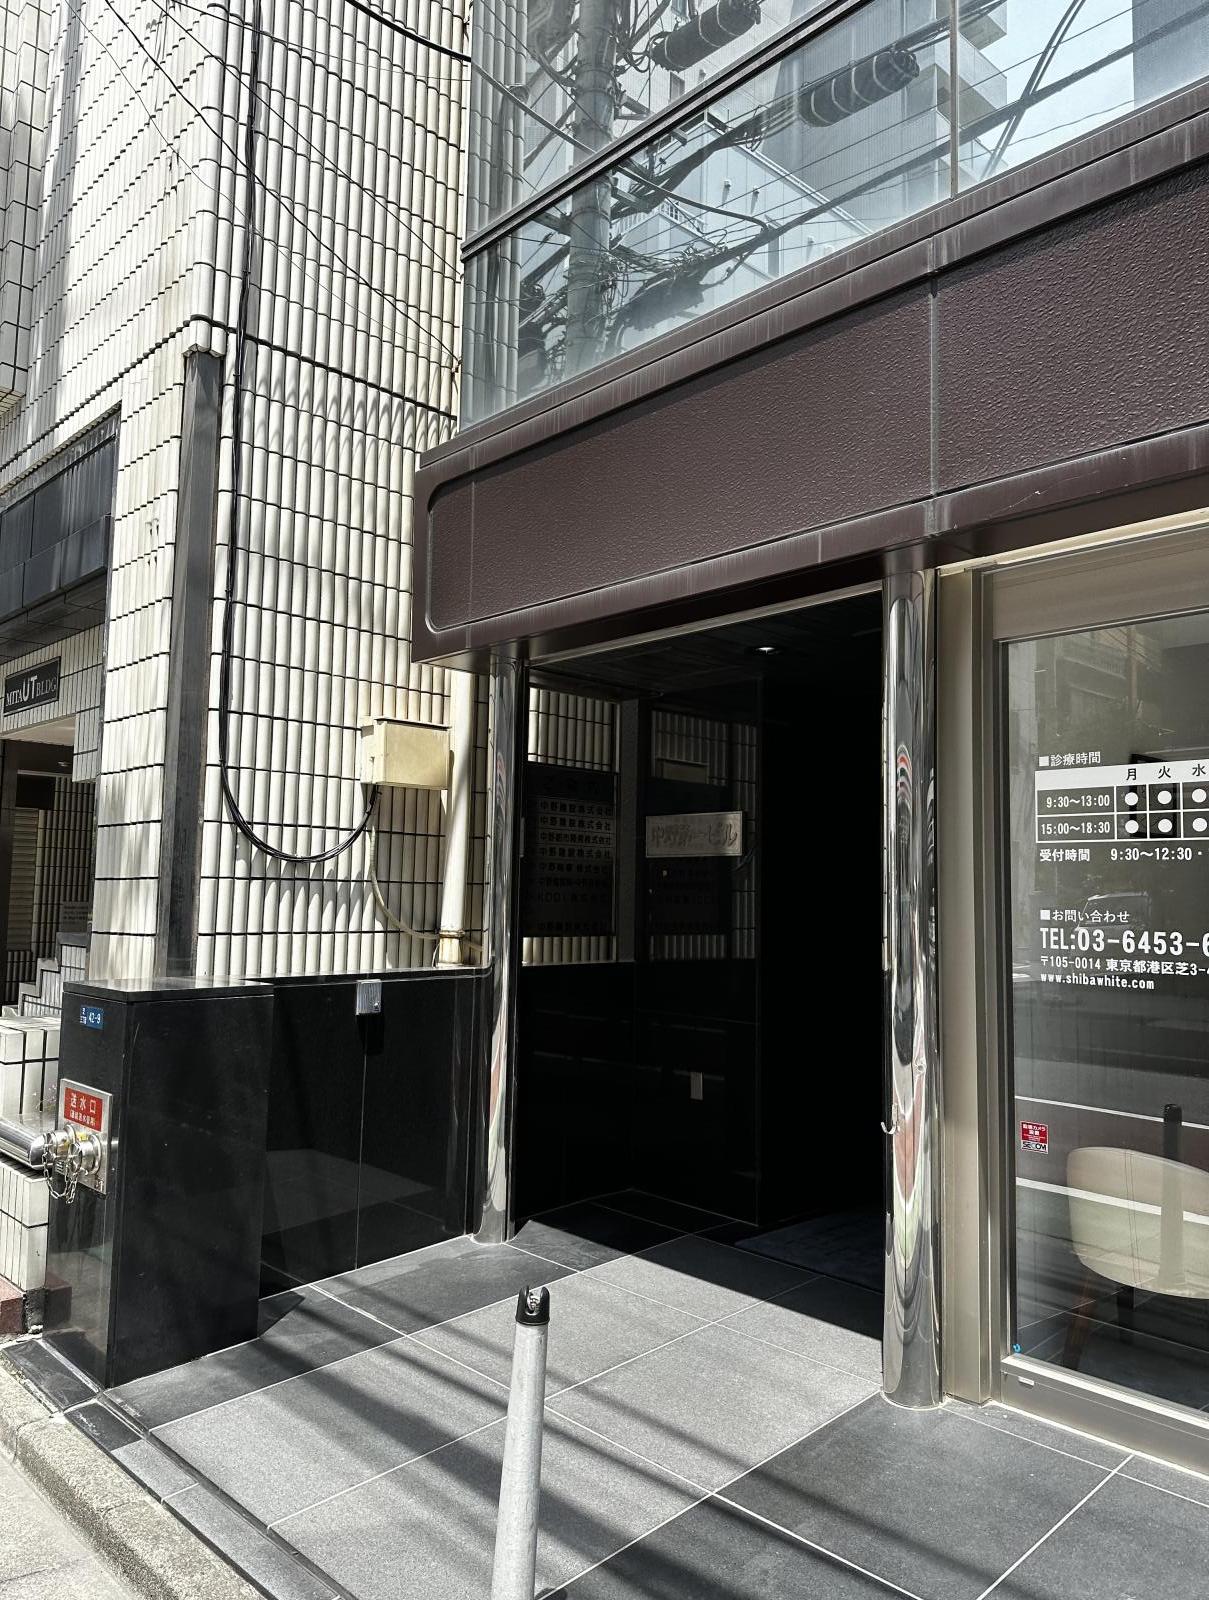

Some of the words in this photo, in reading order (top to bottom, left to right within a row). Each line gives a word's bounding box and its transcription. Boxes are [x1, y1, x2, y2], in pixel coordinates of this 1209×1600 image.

[6, 689, 22, 706] MITA
[22, 675, 38, 702] UT
[1050, 751, 1101, 767] 診療時間
[1126, 768, 1137, 781] 月
[1158, 765, 1171, 779] 火
[1192, 763, 1206, 777] 水
[1039, 848, 1090, 862] 受付時間
[1052, 909, 1130, 923] お問い合わせ
[1106, 958, 1209, 976] 東京都港区芝3-
[1040, 972, 1155, 990] www.shibawhite.com
[70, 1092, 97, 1114] 送水口
[1023, 1140, 1047, 1151] SECOM
